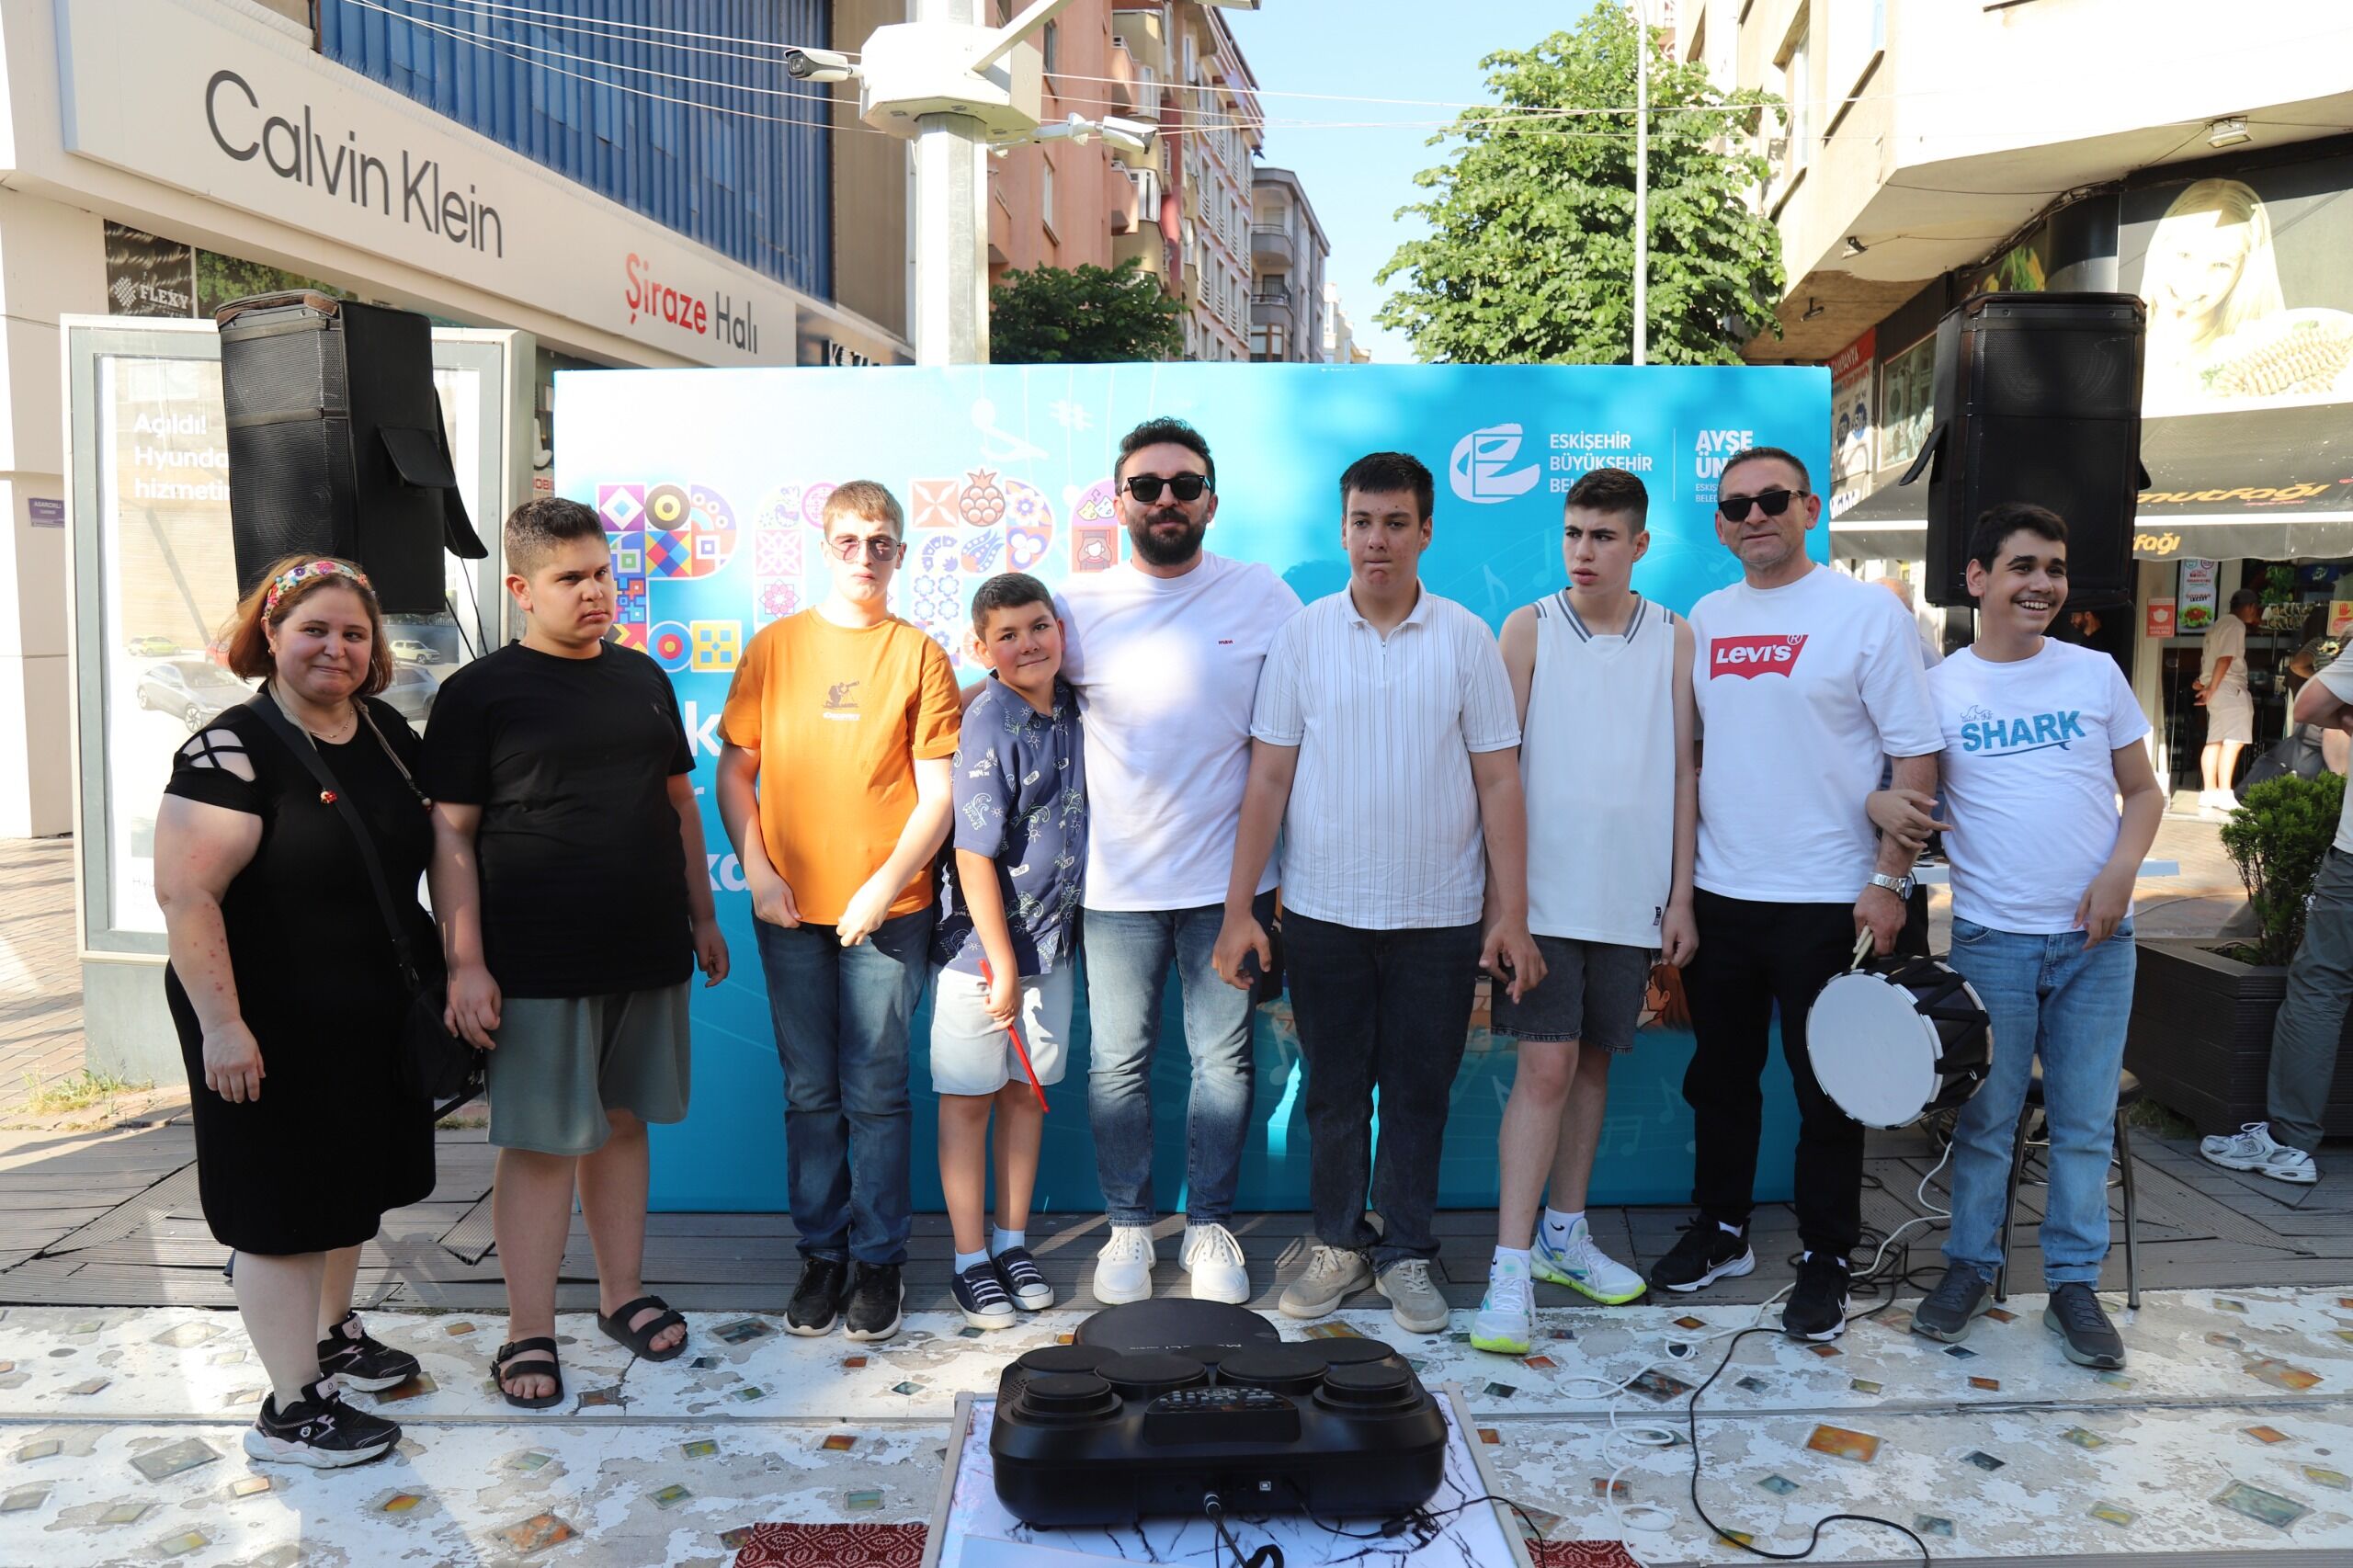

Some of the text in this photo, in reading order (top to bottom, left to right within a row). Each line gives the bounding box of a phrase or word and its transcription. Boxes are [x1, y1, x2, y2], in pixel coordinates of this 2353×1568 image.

[205, 69, 503, 258] Calvin Klein
[140, 283, 189, 310] FLEXY
[625, 252, 757, 355] Şiraze Halı
[1549, 430, 1631, 451] ESKİŞEHİR
[1695, 429, 1754, 455] AYŞE
[134, 445, 230, 471] Hyunda
[1961, 710, 2086, 752] SHARK
